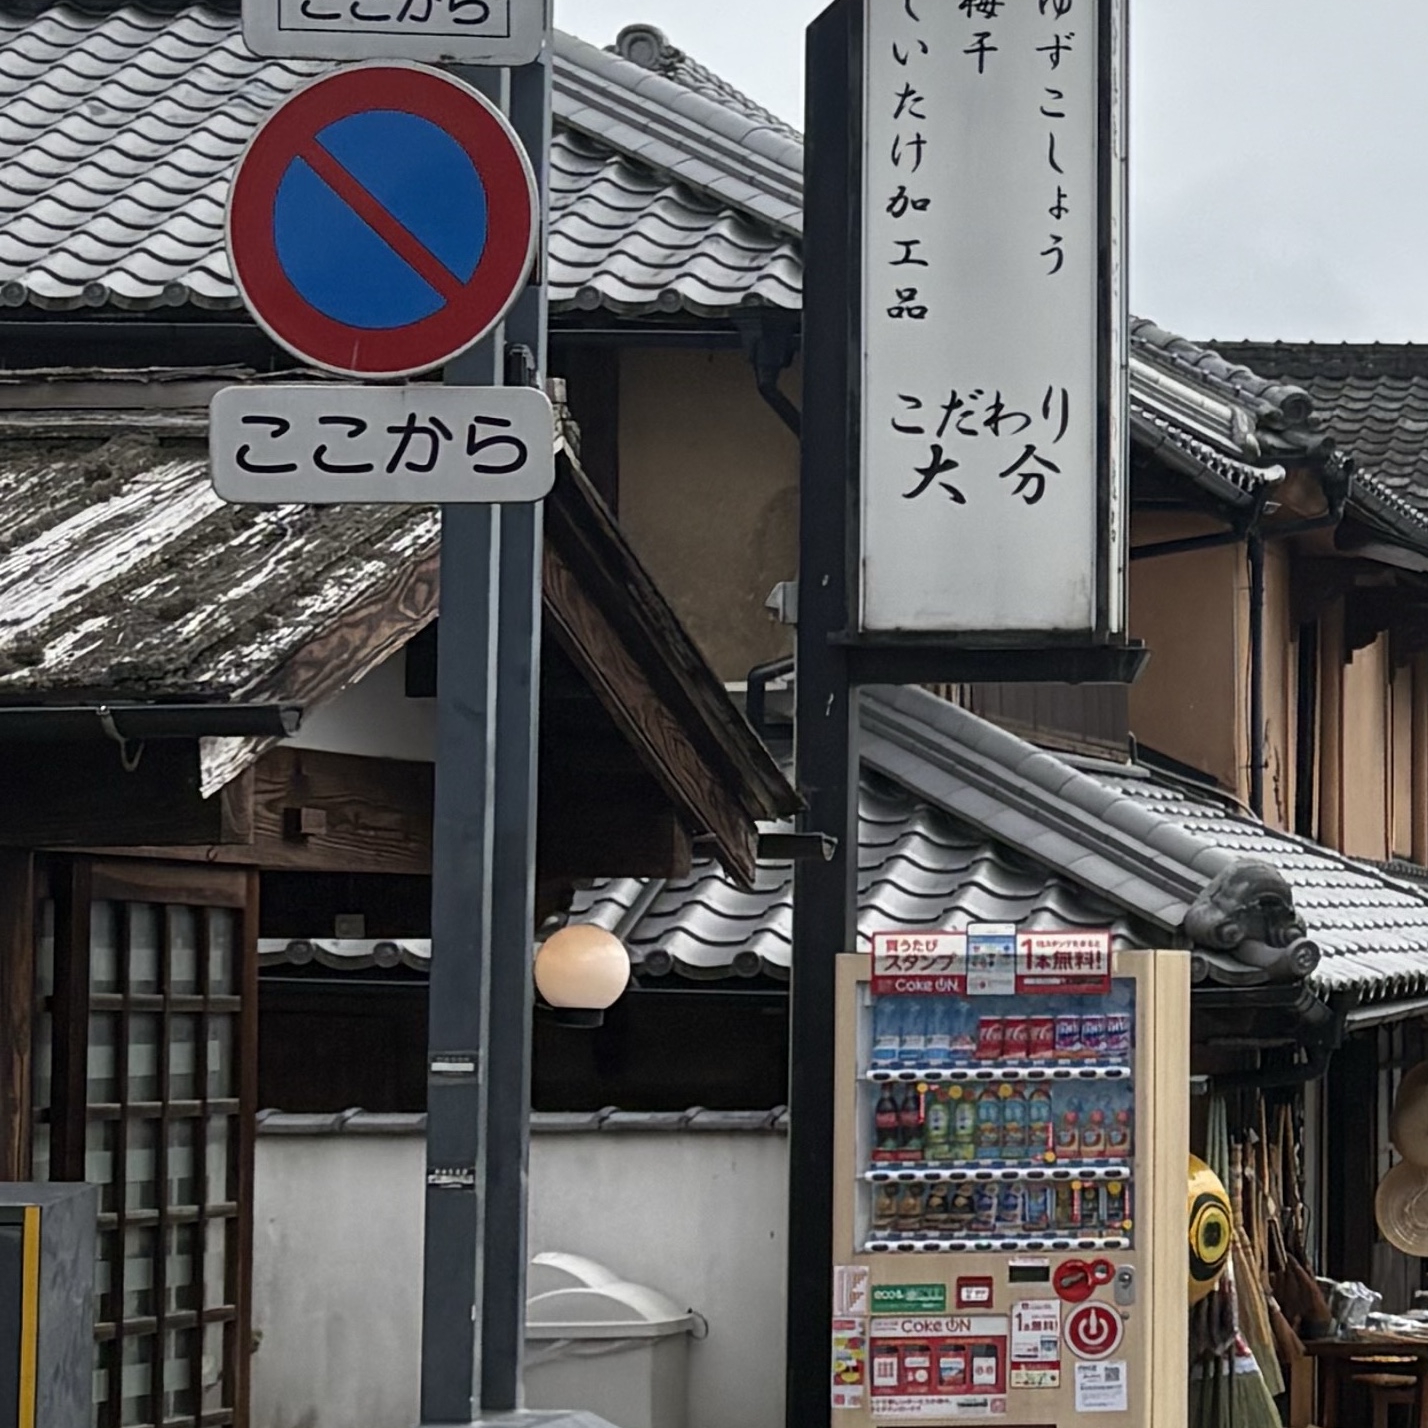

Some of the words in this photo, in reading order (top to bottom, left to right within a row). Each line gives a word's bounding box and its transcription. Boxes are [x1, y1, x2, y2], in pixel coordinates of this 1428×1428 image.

[891, 384, 1069, 444] こだわり
[235, 412, 528, 474] ここから
[902, 444, 1061, 505] 大分
[886, 939, 938, 952] 買うたび
[884, 954, 956, 972] スタンプ
[895, 977, 930, 992] Coke
[901, 1320, 943, 1333] Coke
